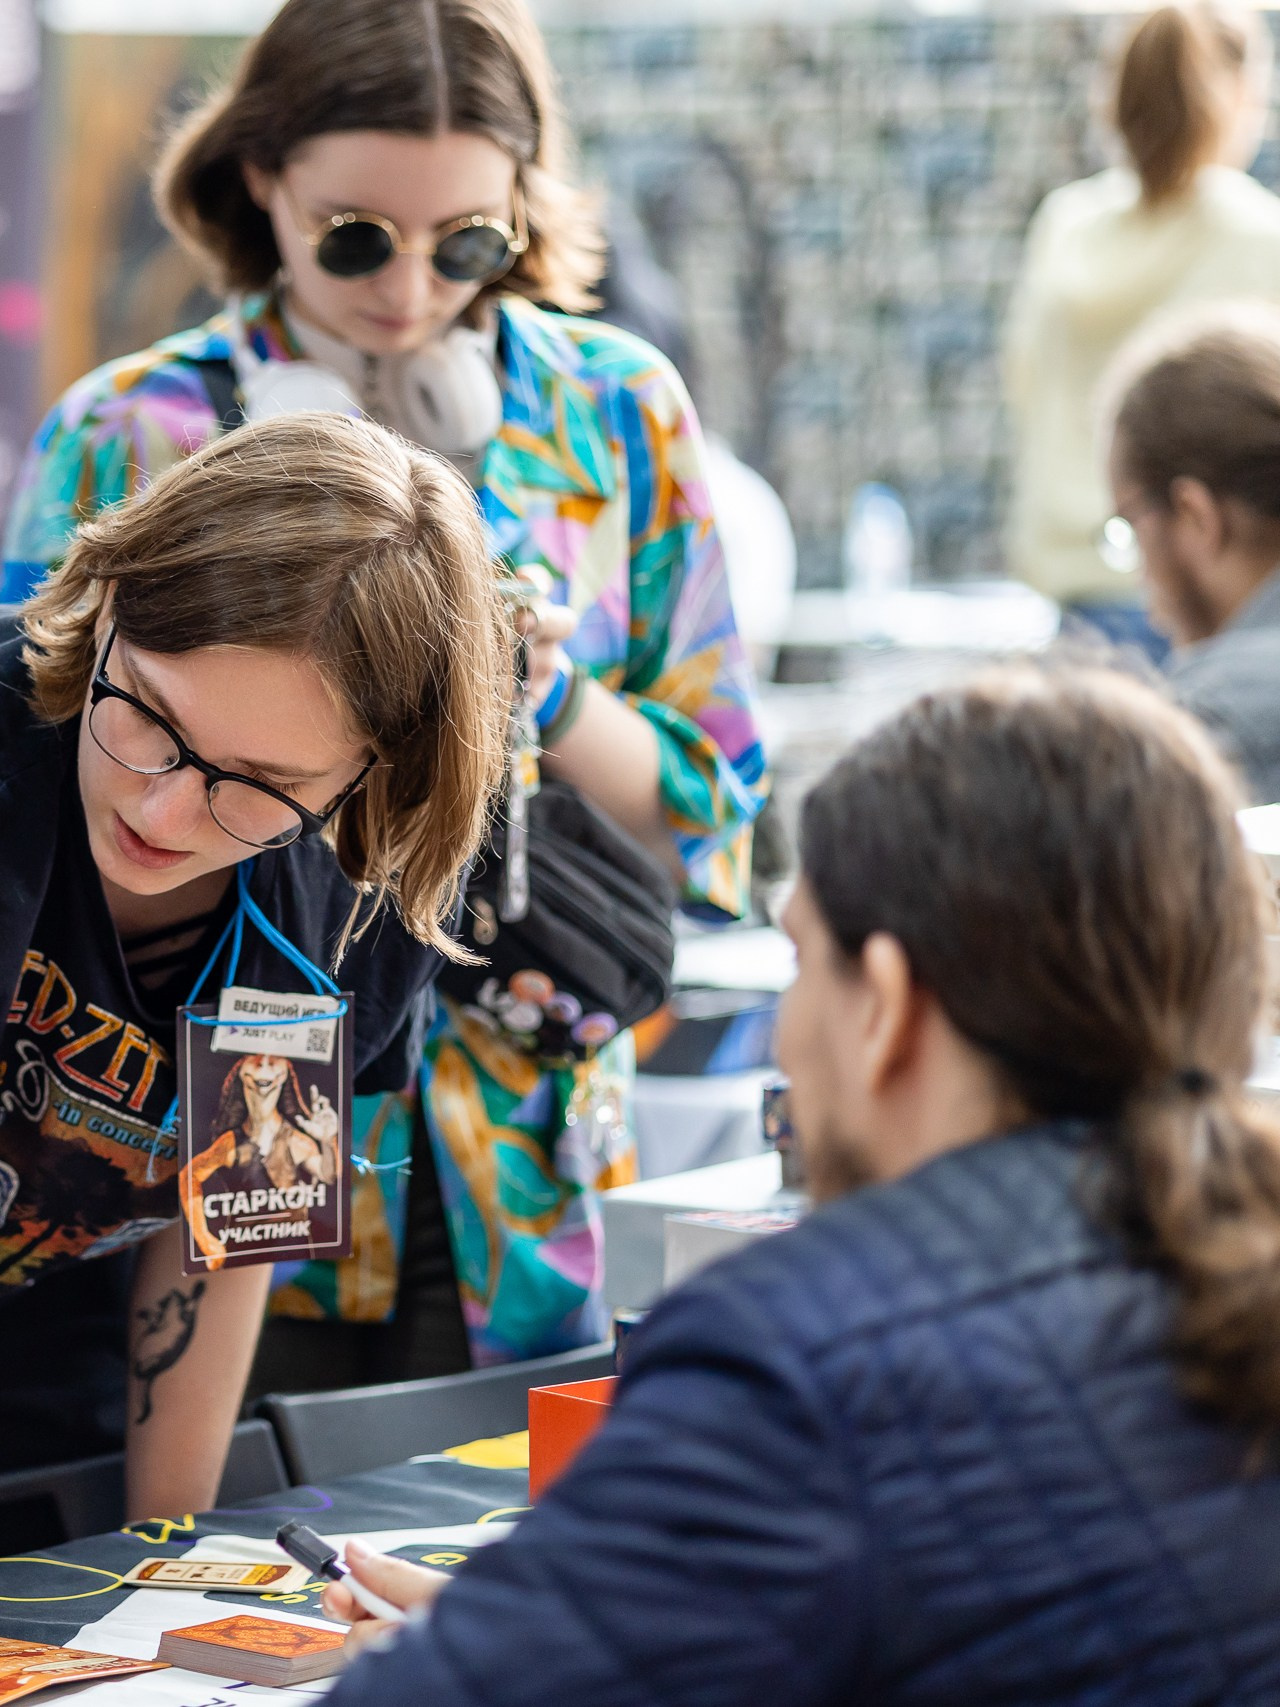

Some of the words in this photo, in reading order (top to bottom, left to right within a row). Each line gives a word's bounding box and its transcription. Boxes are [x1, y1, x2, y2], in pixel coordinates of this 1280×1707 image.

[233, 999, 299, 1018] ВЕДУЩИЙ
[242, 1027, 266, 1038] JUST
[268, 1030, 296, 1041] PLAY
[203, 1182, 327, 1219] СТАРКОН
[218, 1220, 312, 1246] УЧАСТНИК
